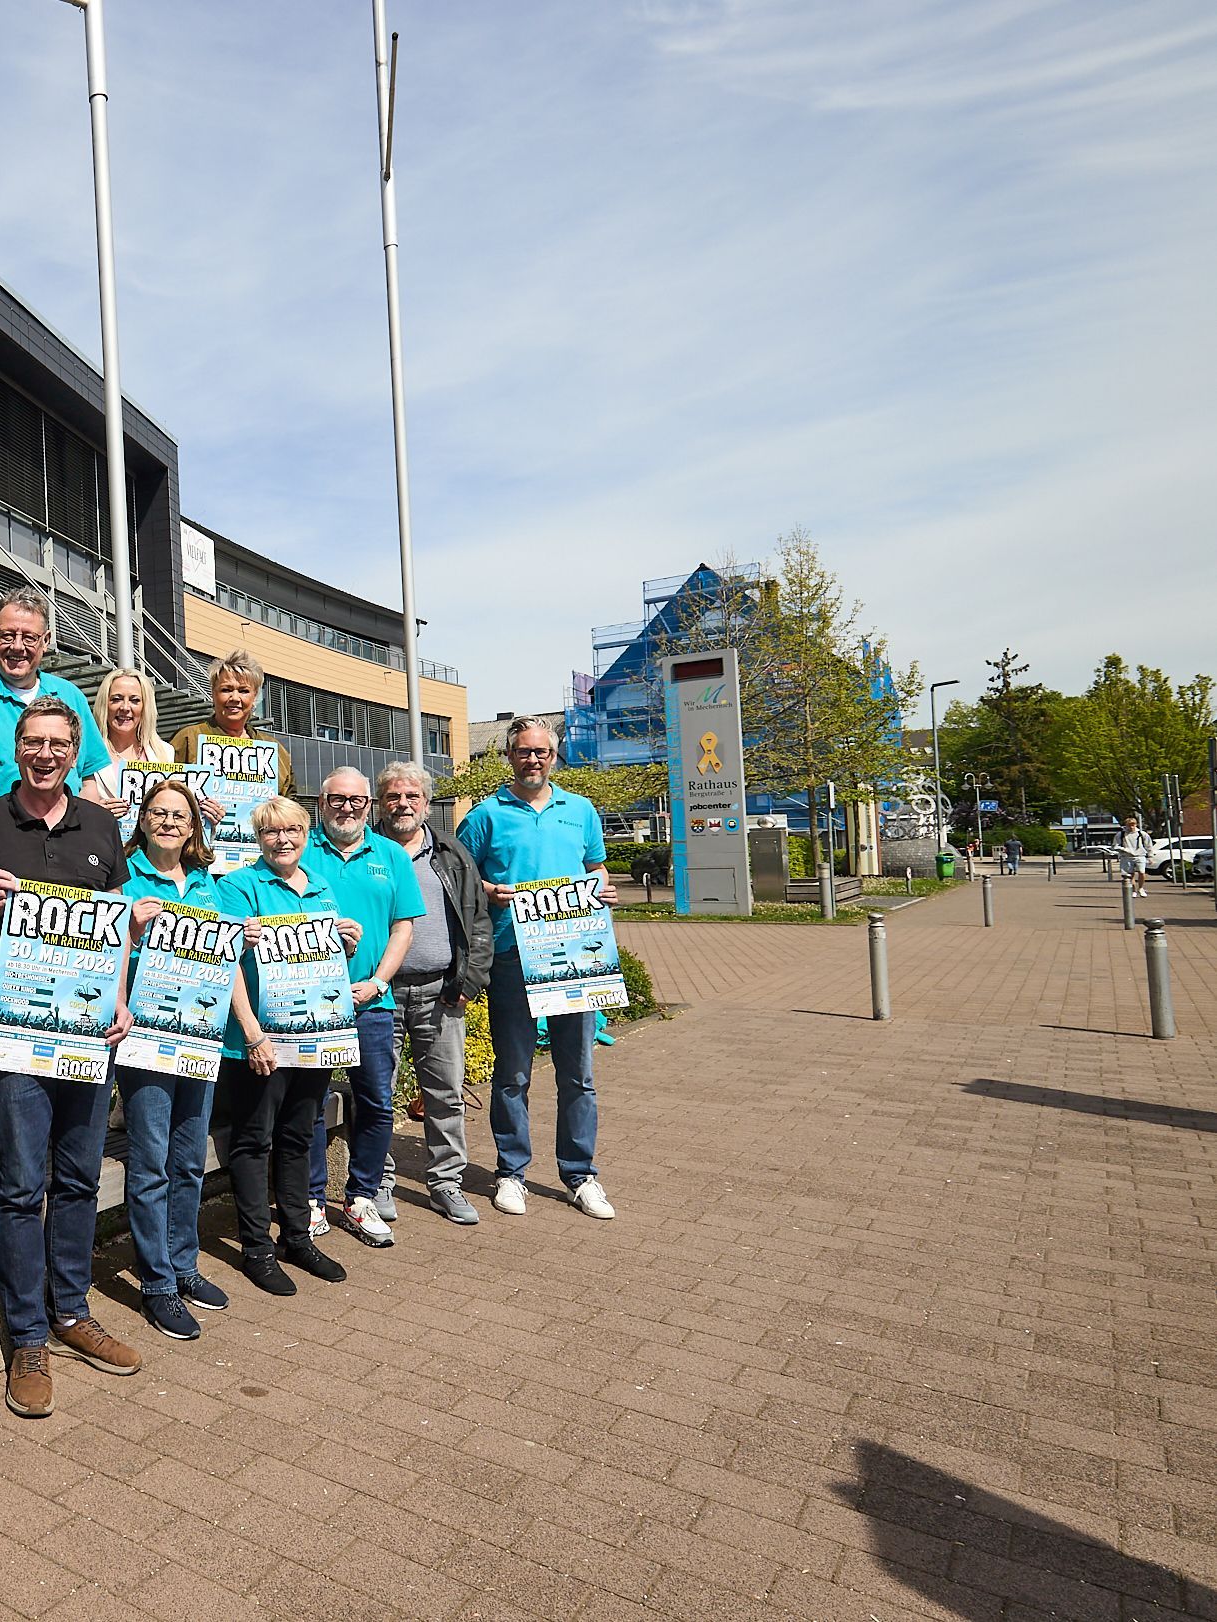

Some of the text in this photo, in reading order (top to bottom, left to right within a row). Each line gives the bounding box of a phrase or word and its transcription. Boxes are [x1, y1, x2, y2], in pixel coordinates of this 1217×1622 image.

[207, 736, 253, 747] MECHERNICHER
[126, 761, 184, 773] MECHERNICHER
[200, 743, 275, 779] ROCK
[239, 773, 264, 782] RATHAUS
[688, 780, 738, 791] Rathaus
[212, 780, 274, 798] 0. Mai 2026
[689, 790, 725, 798] Bergstraße
[689, 802, 732, 812] jobcenter
[20, 883, 91, 901] MECHERNICHER
[515, 878, 570, 890] MECHERNICHER
[513, 879, 605, 923] ROCK
[8, 891, 126, 947] ROCK
[162, 903, 218, 921] MECHERNICHER
[545, 908, 592, 921] AM RATHAUS
[148, 909, 243, 962] ROCK
[522, 917, 607, 936] 30. Mai 2026
[45, 934, 59, 945] AM
[63, 936, 104, 951] RATHAUS
[257, 918, 341, 963] ROCK
[9, 939, 117, 975] 30. Mai 2026
[176, 948, 187, 958] AM
[190, 951, 222, 965] RATHAUS
[287, 952, 329, 963] AM RATHAUS
[50, 967, 79, 976] Mechernich
[147, 952, 169, 971] 30.
[172, 958, 195, 977] Mai
[197, 965, 231, 986] 2026
[265, 963, 343, 979] 30. Mai 2026
[587, 991, 625, 1009] ROCK
[321, 1048, 357, 1066] ROCK
[58, 1058, 102, 1079] ROCK
[177, 1056, 216, 1077] ROCK
